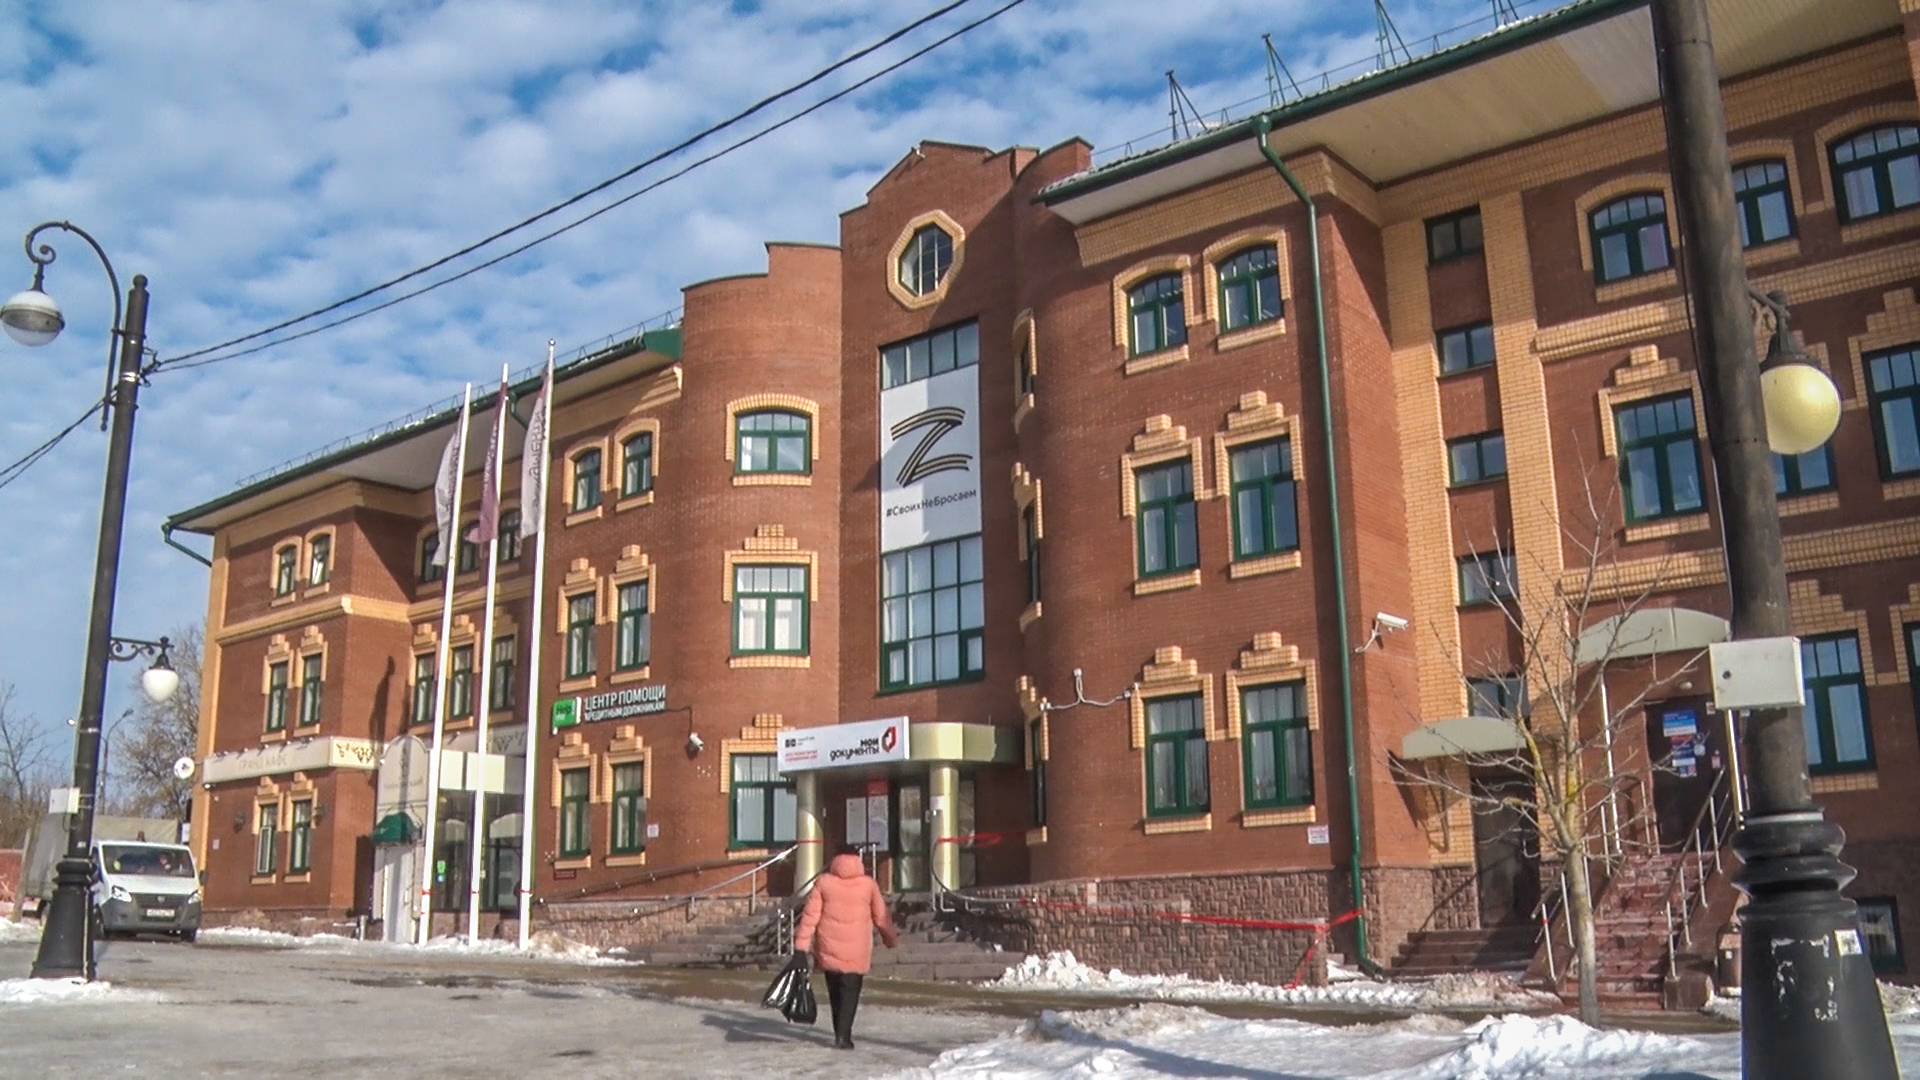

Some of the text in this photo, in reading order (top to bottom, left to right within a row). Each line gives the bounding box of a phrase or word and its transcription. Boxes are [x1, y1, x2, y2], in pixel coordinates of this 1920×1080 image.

[886, 489, 977, 517] #СвоихНеБросаем
[583, 692, 618, 711] ЦЕНТР
[618, 684, 666, 705] ПОМОЩИ
